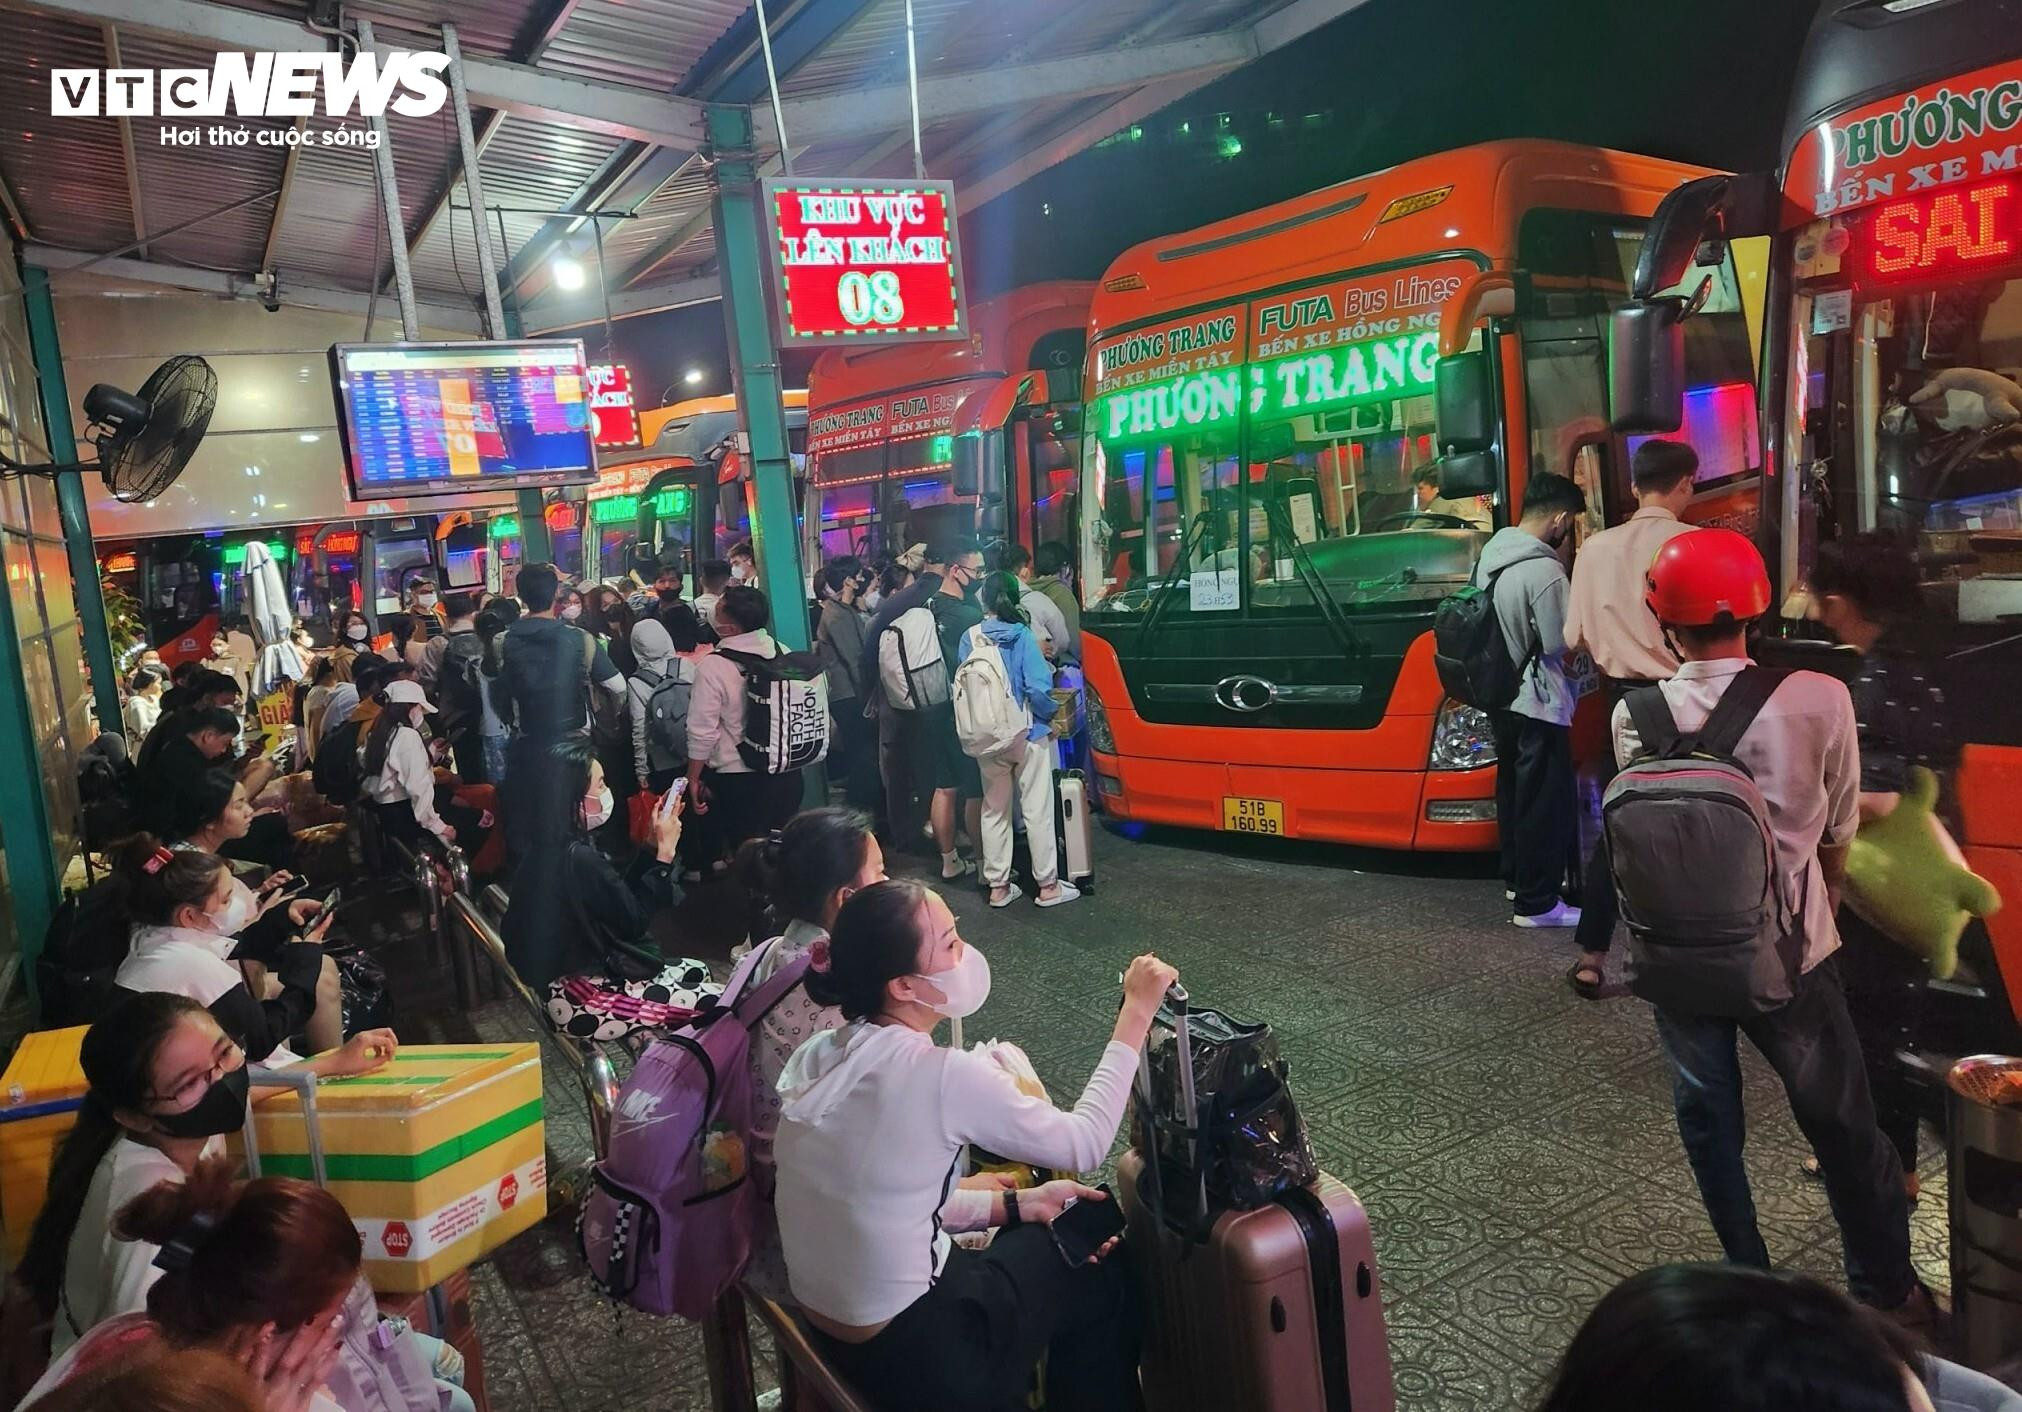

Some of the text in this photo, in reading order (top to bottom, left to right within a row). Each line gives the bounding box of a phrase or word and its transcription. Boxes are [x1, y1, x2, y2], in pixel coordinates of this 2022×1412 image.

[1815, 171, 1896, 216] BẾN
[1907, 156, 1969, 192] XE
[798, 192, 926, 234] KHU VỰC
[784, 228, 946, 265] LÊN KHÁCH
[838, 271, 904, 325] 08
[1259, 275, 1462, 336] FUTA Bus Lines
[1100, 315, 1236, 370] PHƯƠNG TRANG
[1258, 311, 1441, 357] BẾN XE HỒNG NG
[1124, 370, 1145, 386] XE
[1150, 357, 1191, 380] MIỀN
[1195, 350, 1233, 370] TÂY
[1277, 331, 1440, 408] TRANG
[847, 404, 884, 428] TRANG
[892, 396, 930, 420] FUTA
[932, 393, 954, 413] Bus
[915, 419, 931, 431] XE
[790, 703, 804, 744] FACE
[803, 685, 817, 742] NORTH
[814, 705, 825, 741] THE
[1232, 816, 1277, 833] 160.99
[1240, 800, 1265, 816] 51B
[500, 1186, 516, 1202] STOP
[386, 1234, 410, 1247] STOP
